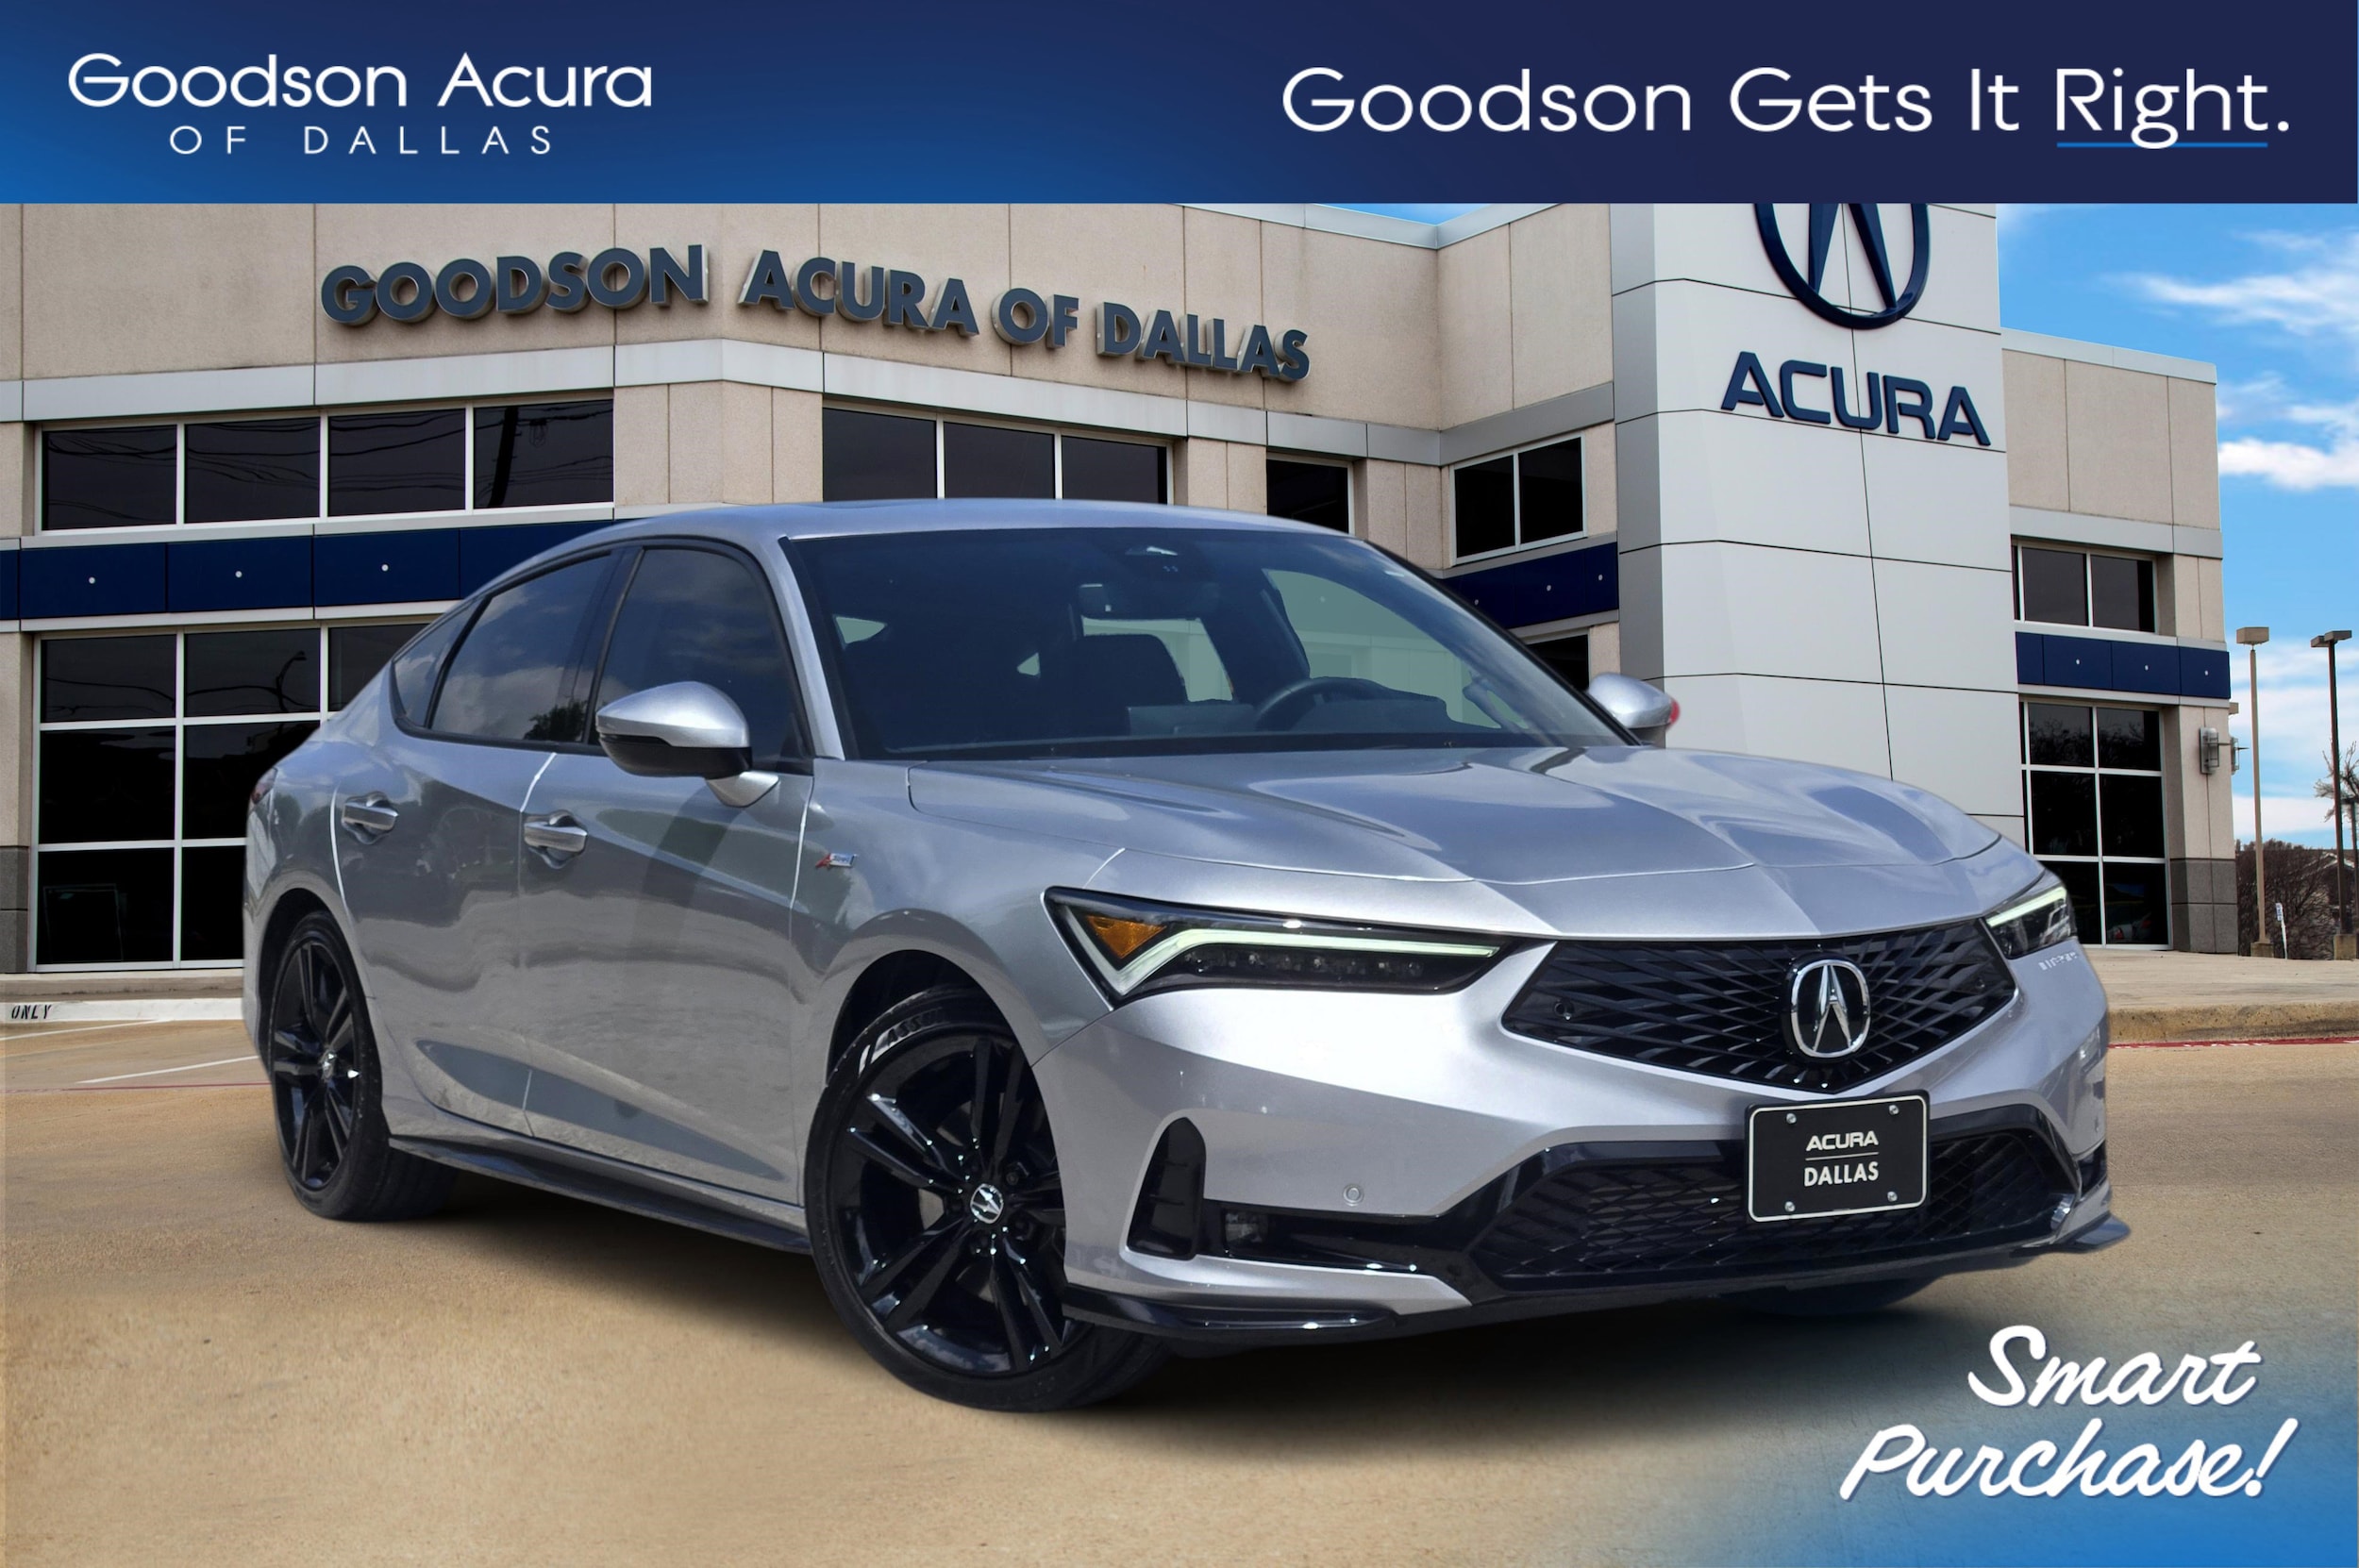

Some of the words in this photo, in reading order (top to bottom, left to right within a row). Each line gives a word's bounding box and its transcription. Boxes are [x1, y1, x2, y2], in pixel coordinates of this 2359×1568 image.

[321, 244, 708, 325] GOODSON
[738, 249, 980, 337] ACURA
[992, 288, 1079, 349] OF
[1096, 302, 1311, 382] DALLAS
[1720, 351, 1991, 446] ACURA
[11, 1005, 52, 1019] ONLY
[1805, 1130, 1879, 1152] ACURA
[1804, 1160, 1879, 1187] DALLAS
